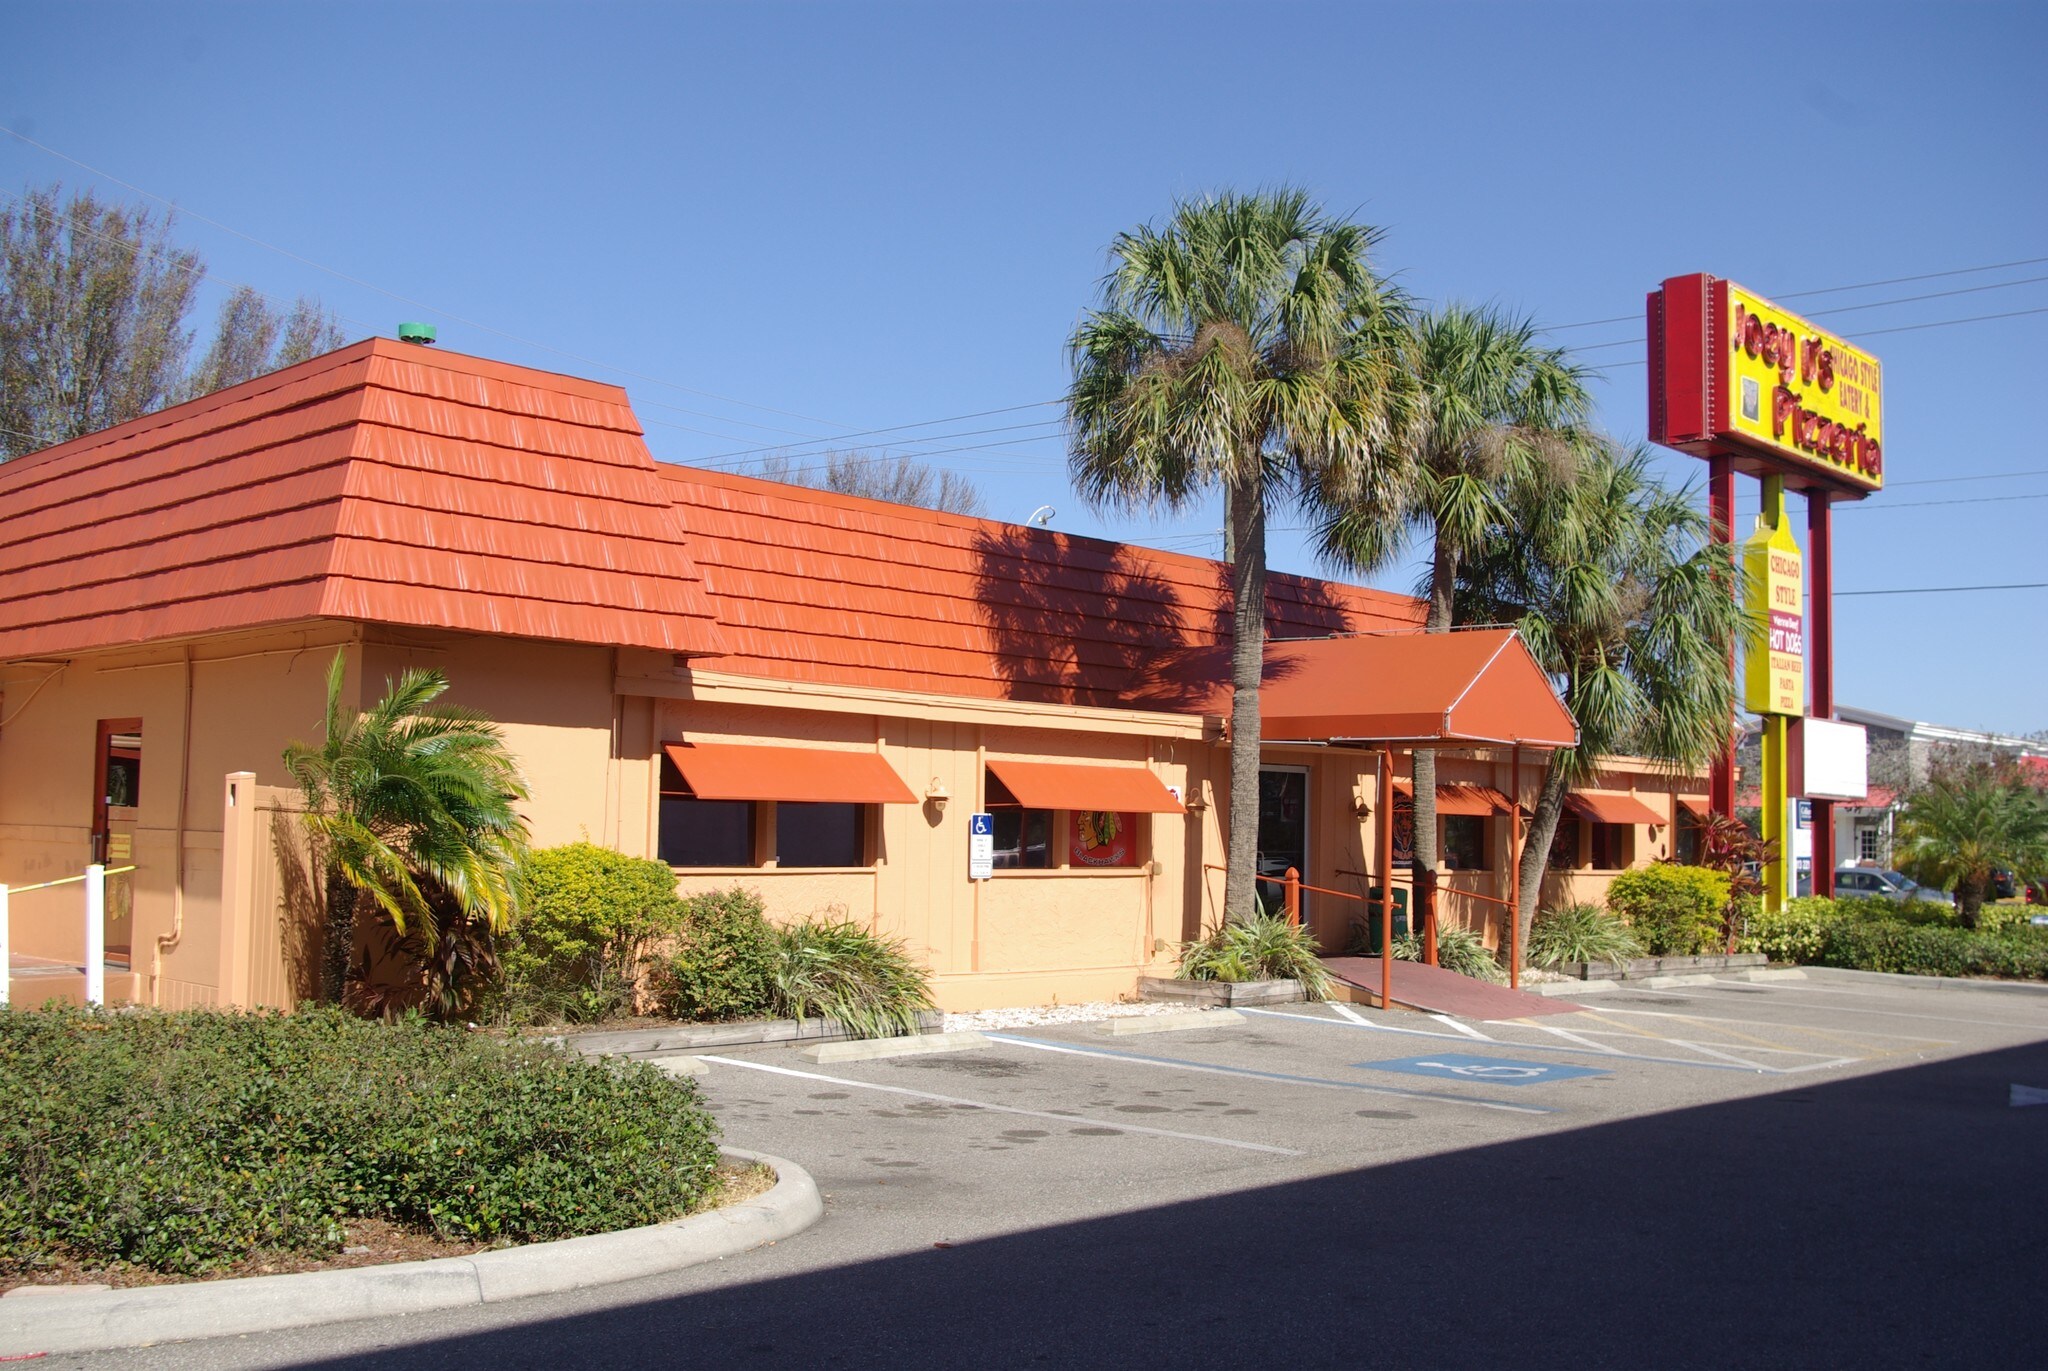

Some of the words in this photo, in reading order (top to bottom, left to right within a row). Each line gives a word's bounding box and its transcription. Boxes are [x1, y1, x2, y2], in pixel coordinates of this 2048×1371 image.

[1734, 302, 1795, 386] Joey
[1861, 361, 1878, 393] STYLE
[1840, 380, 1862, 416] EATERY
[1772, 386, 1881, 475] Pizzeria
[1771, 555, 1799, 578] CHICAGO
[1776, 585, 1796, 606] STYLE
[1770, 628, 1784, 649] HOT
[1785, 632, 1802, 654] DOGS
[1771, 656, 1790, 671] ITALIAN
[1791, 660, 1802, 673] BEEF
[1779, 677, 1794, 691] PASTA
[1780, 695, 1794, 709] PIZZA
[1074, 847, 1125, 865] BLACKHAWKS
